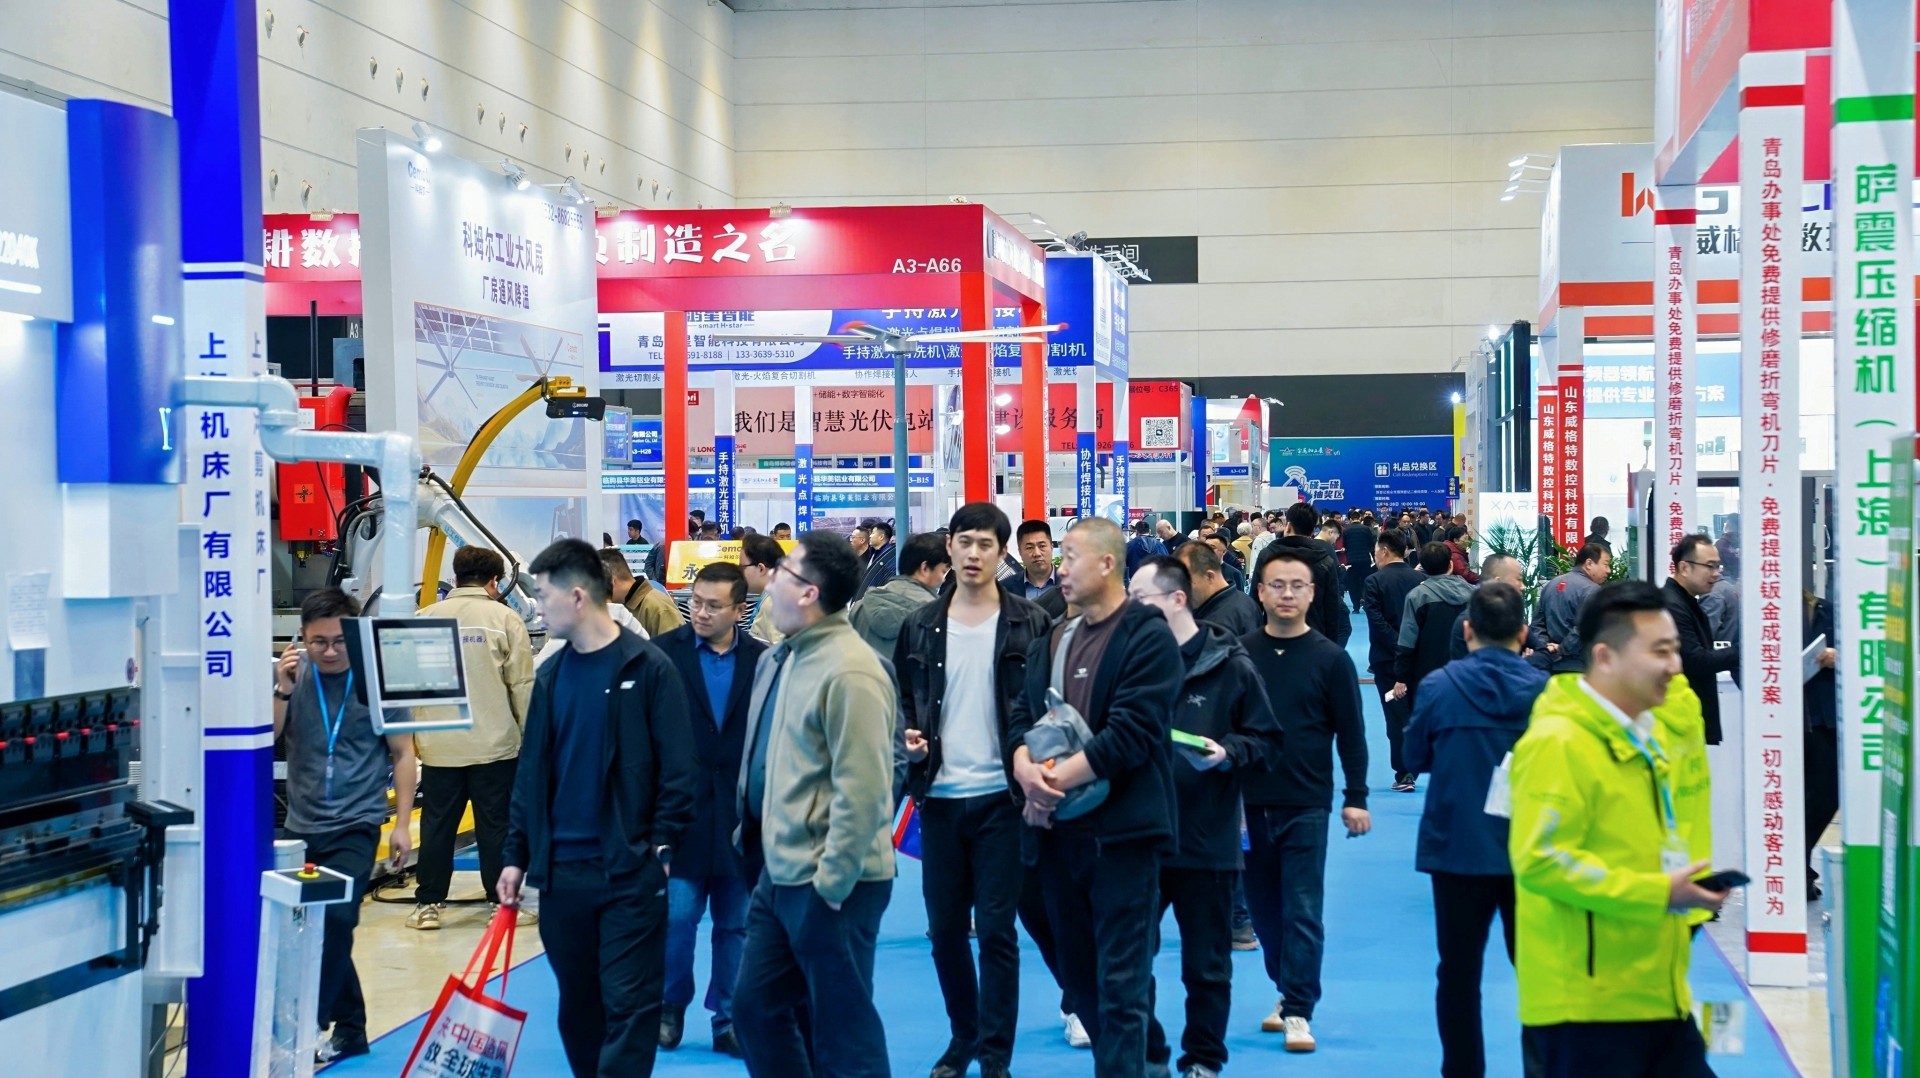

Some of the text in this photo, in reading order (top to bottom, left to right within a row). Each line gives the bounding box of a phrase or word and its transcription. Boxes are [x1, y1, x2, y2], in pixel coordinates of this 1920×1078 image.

[462, 221, 544, 275] 科姆尔工业大风扇
[892, 258, 962, 274] A3-A66
[482, 276, 530, 310] 厂房通风降温
[615, 373, 661, 383] 激光切割头
[908, 476, 930, 484] 3-B15
[1392, 461, 1438, 472] 礼品兑换区
[199, 331, 233, 678] 上机床厂有限公司
[718, 451, 730, 535] 手持激光清洗机
[796, 457, 808, 532] 激光点焊机
